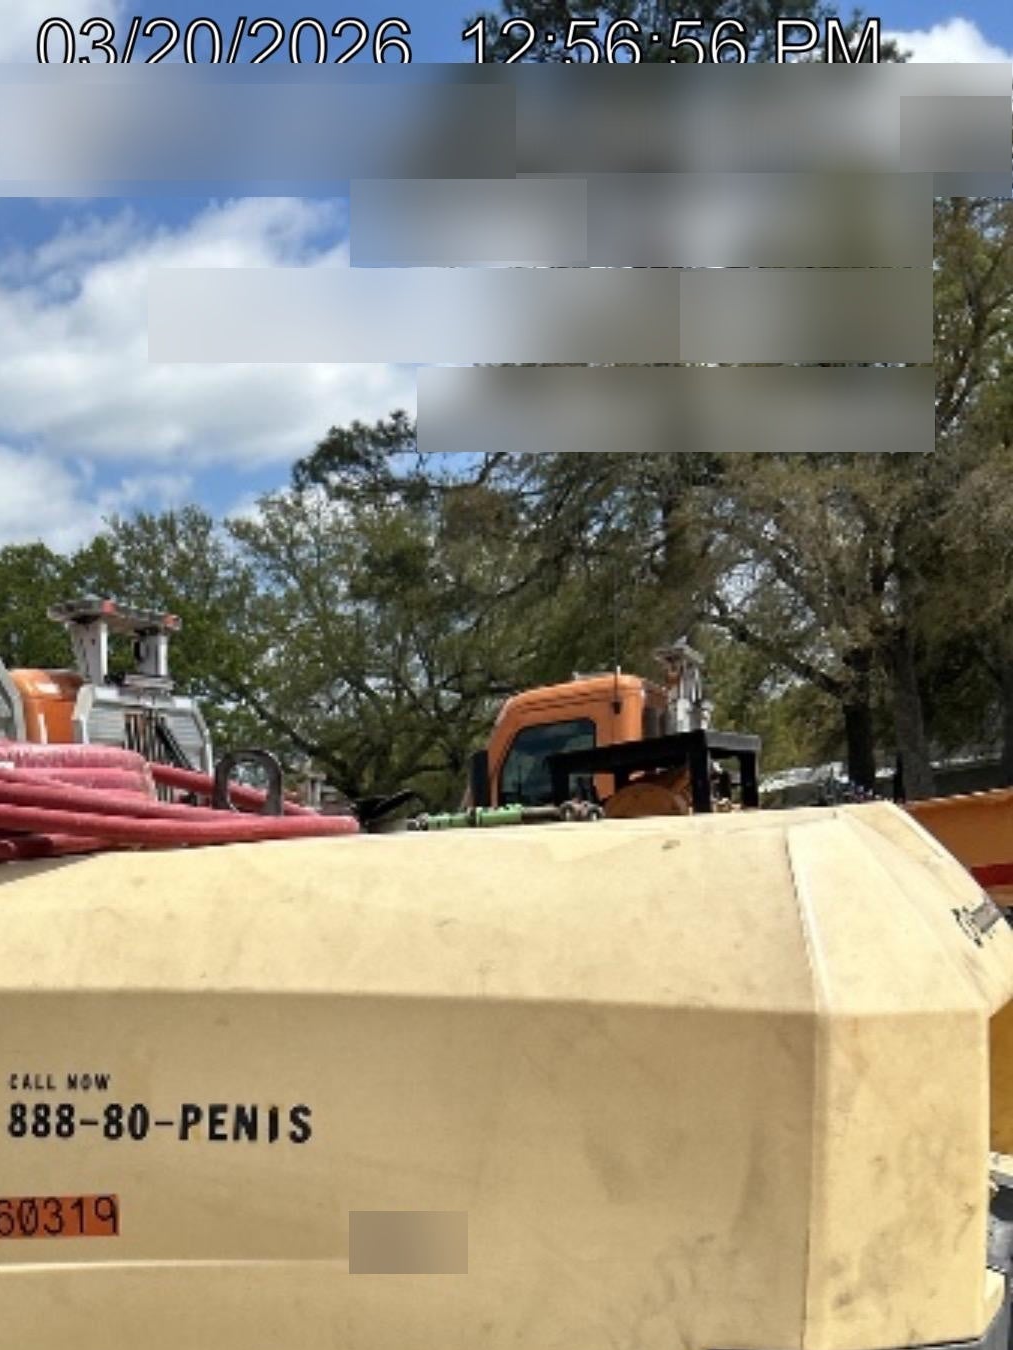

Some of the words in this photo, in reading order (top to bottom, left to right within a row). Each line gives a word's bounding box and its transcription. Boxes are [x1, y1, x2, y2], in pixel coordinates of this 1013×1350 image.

[9, 1074, 56, 1090] CALL
[69, 1074, 111, 1090] NOW
[8, 1103, 313, 1143] 888-80-PENIS
